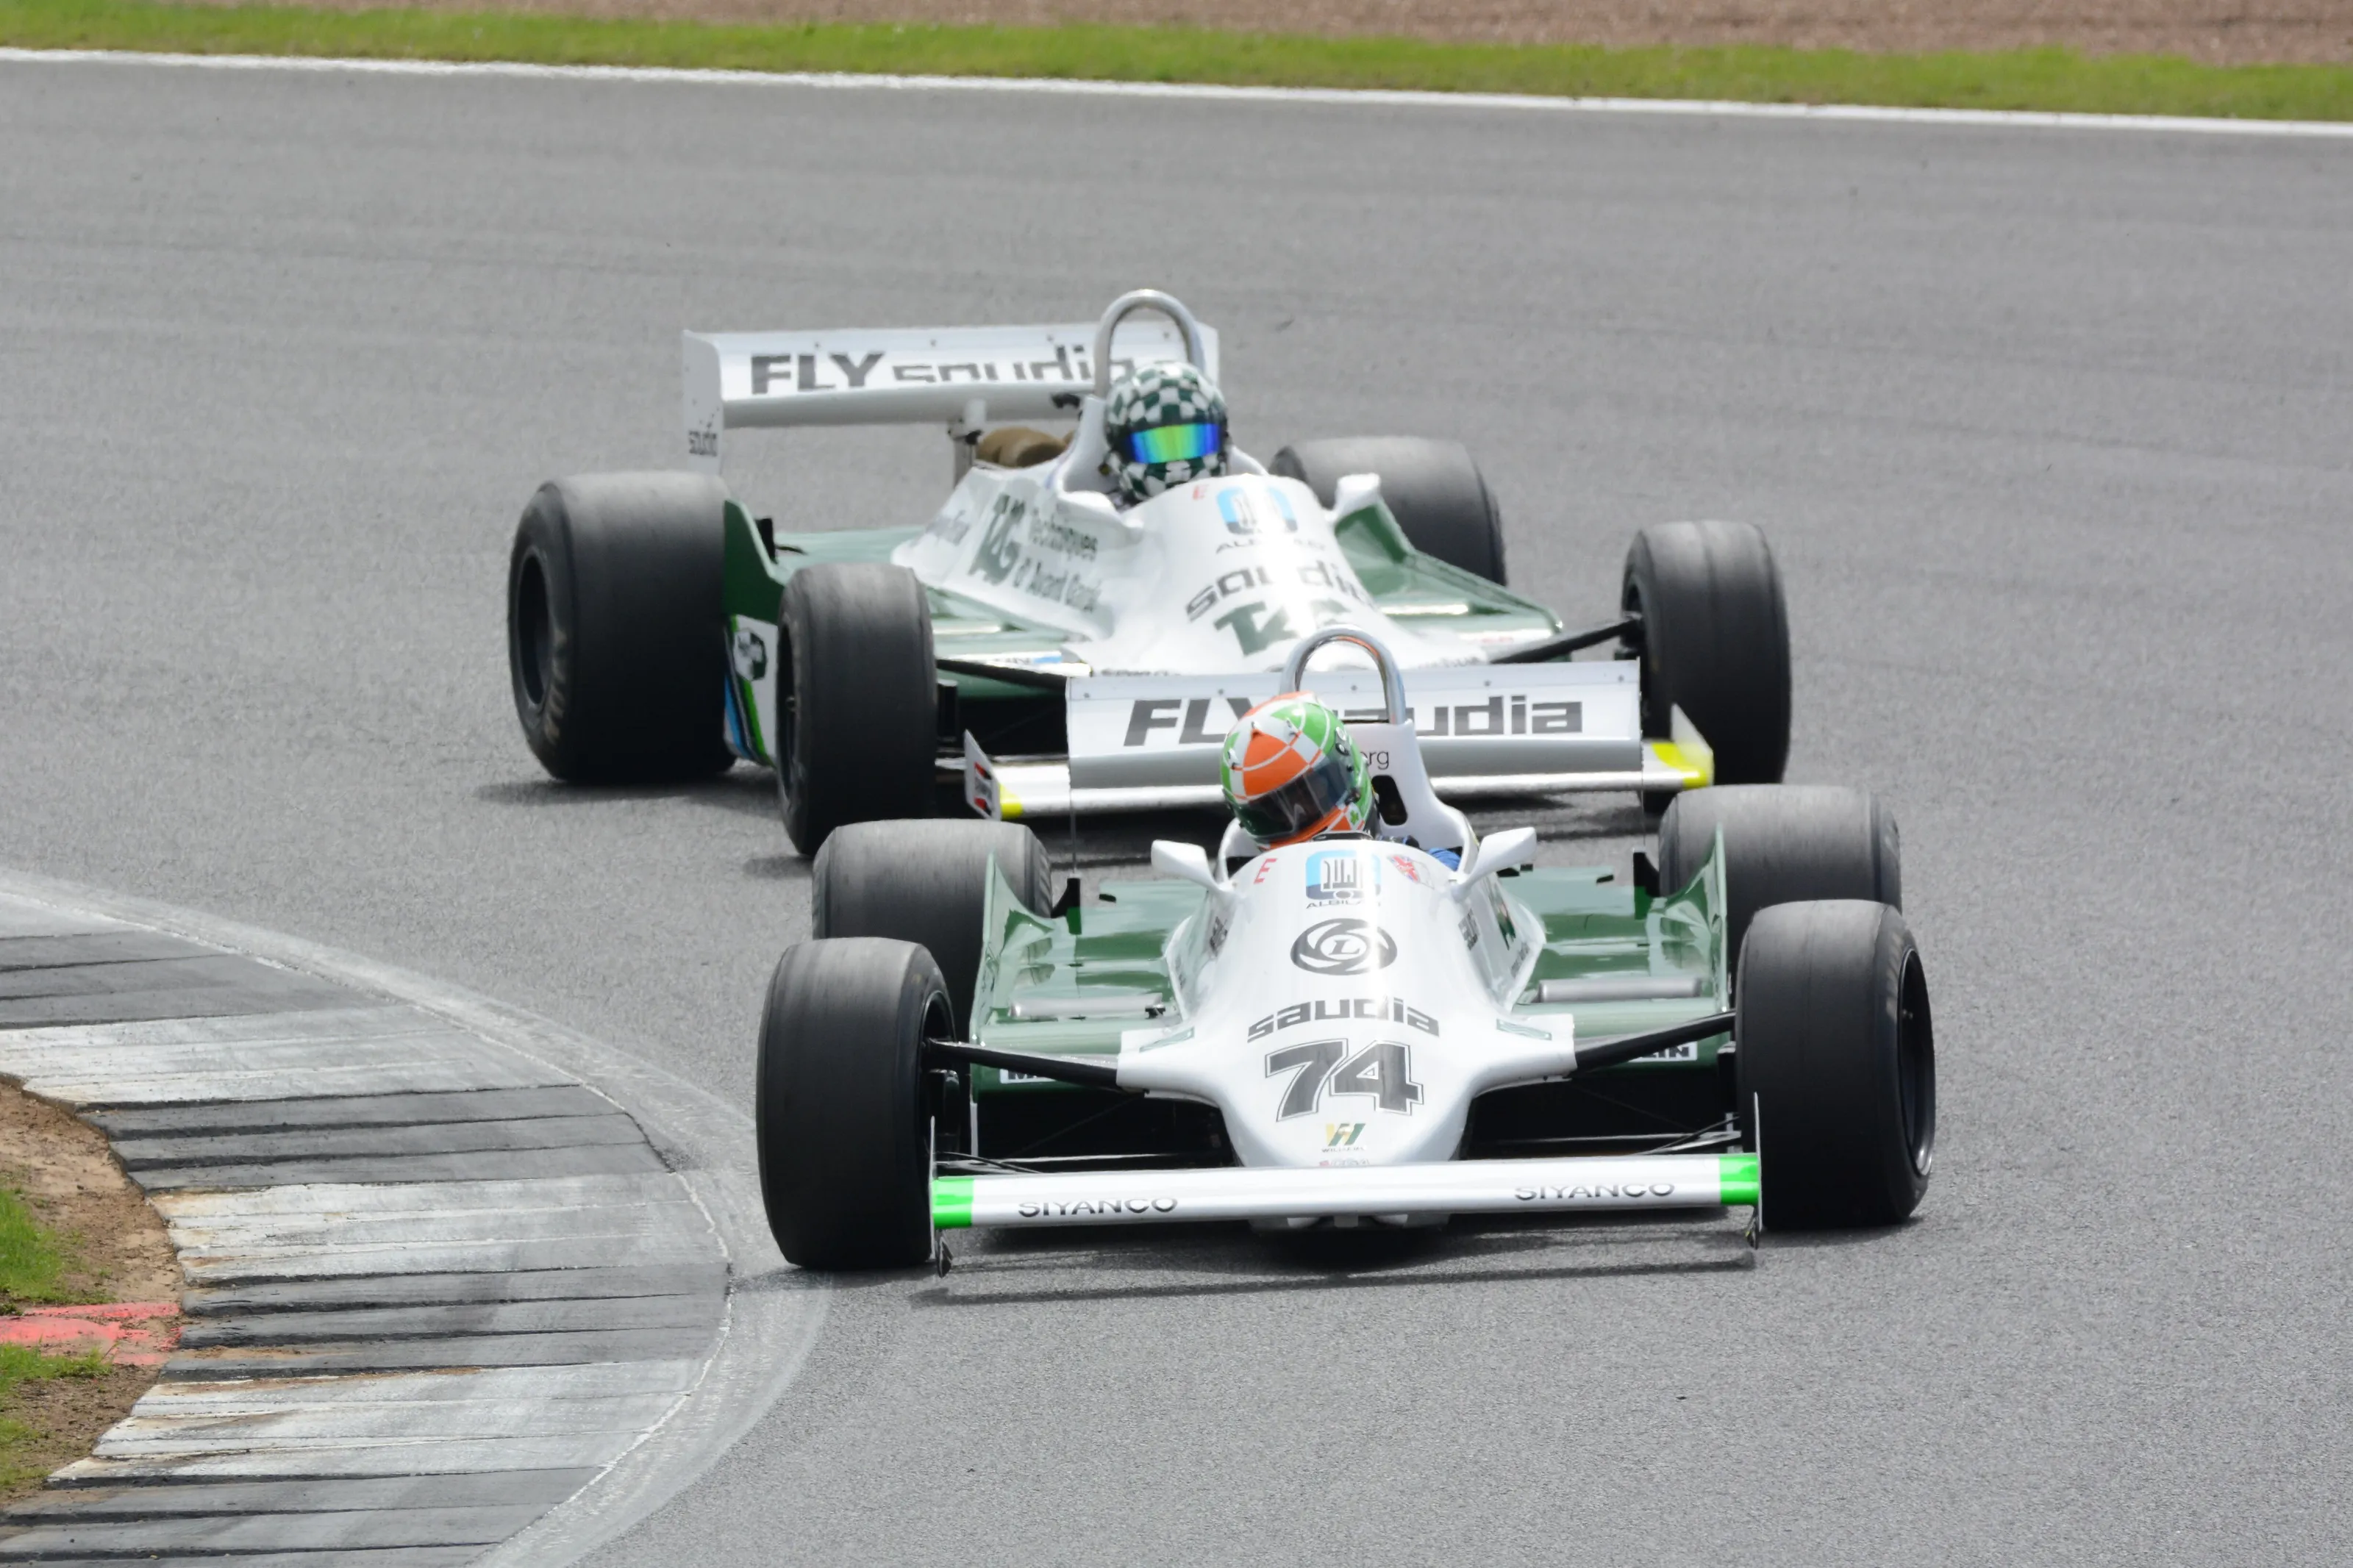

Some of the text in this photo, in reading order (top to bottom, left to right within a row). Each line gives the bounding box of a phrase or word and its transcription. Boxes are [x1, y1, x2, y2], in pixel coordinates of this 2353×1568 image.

[751, 351, 886, 395] FLY
[1331, 695, 1583, 736] audia
[1254, 858, 1278, 885] E
[1305, 899, 1381, 909] ALBIL
[1246, 996, 1440, 1043] saudia
[1264, 1038, 1424, 1123] 74
[1018, 1198, 1178, 1218] SIYANCO
[1514, 1183, 1676, 1202] SIYANCO
